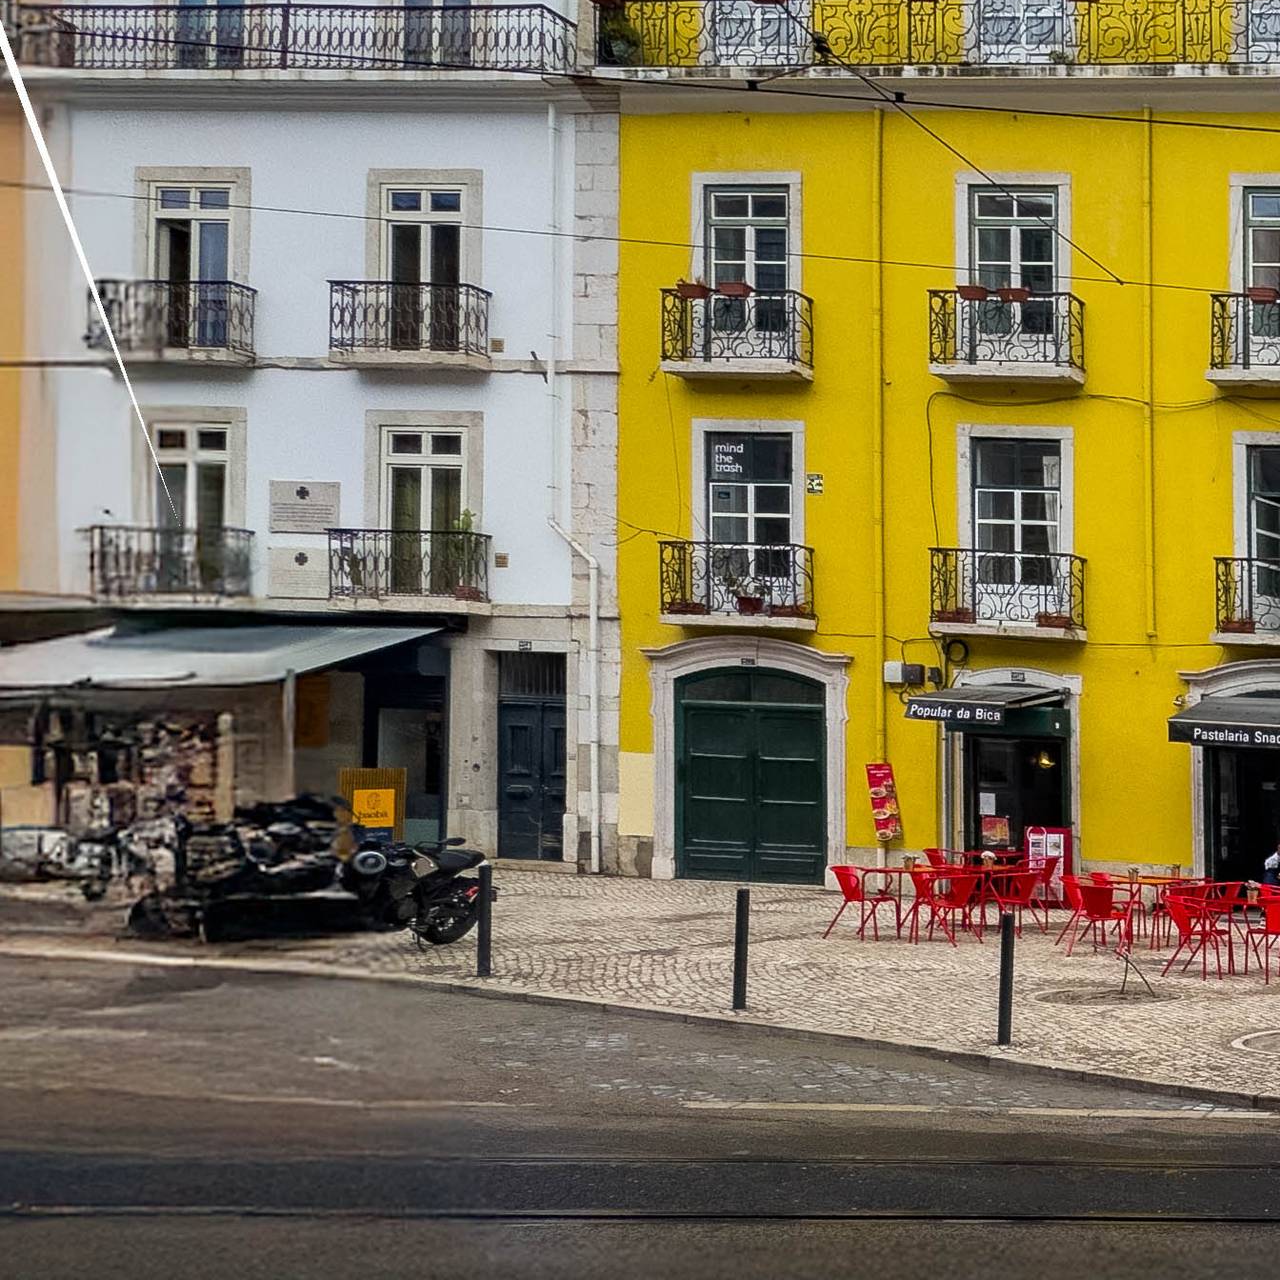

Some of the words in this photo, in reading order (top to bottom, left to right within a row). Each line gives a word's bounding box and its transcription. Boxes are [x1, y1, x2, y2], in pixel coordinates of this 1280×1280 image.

[715, 443, 744, 453] mind
[715, 453, 733, 463] the
[715, 462, 743, 472] trash
[910, 704, 953, 718] Popular
[956, 708, 970, 719] da
[975, 708, 1001, 720] Bica
[1194, 728, 1249, 742] Pastelaria
